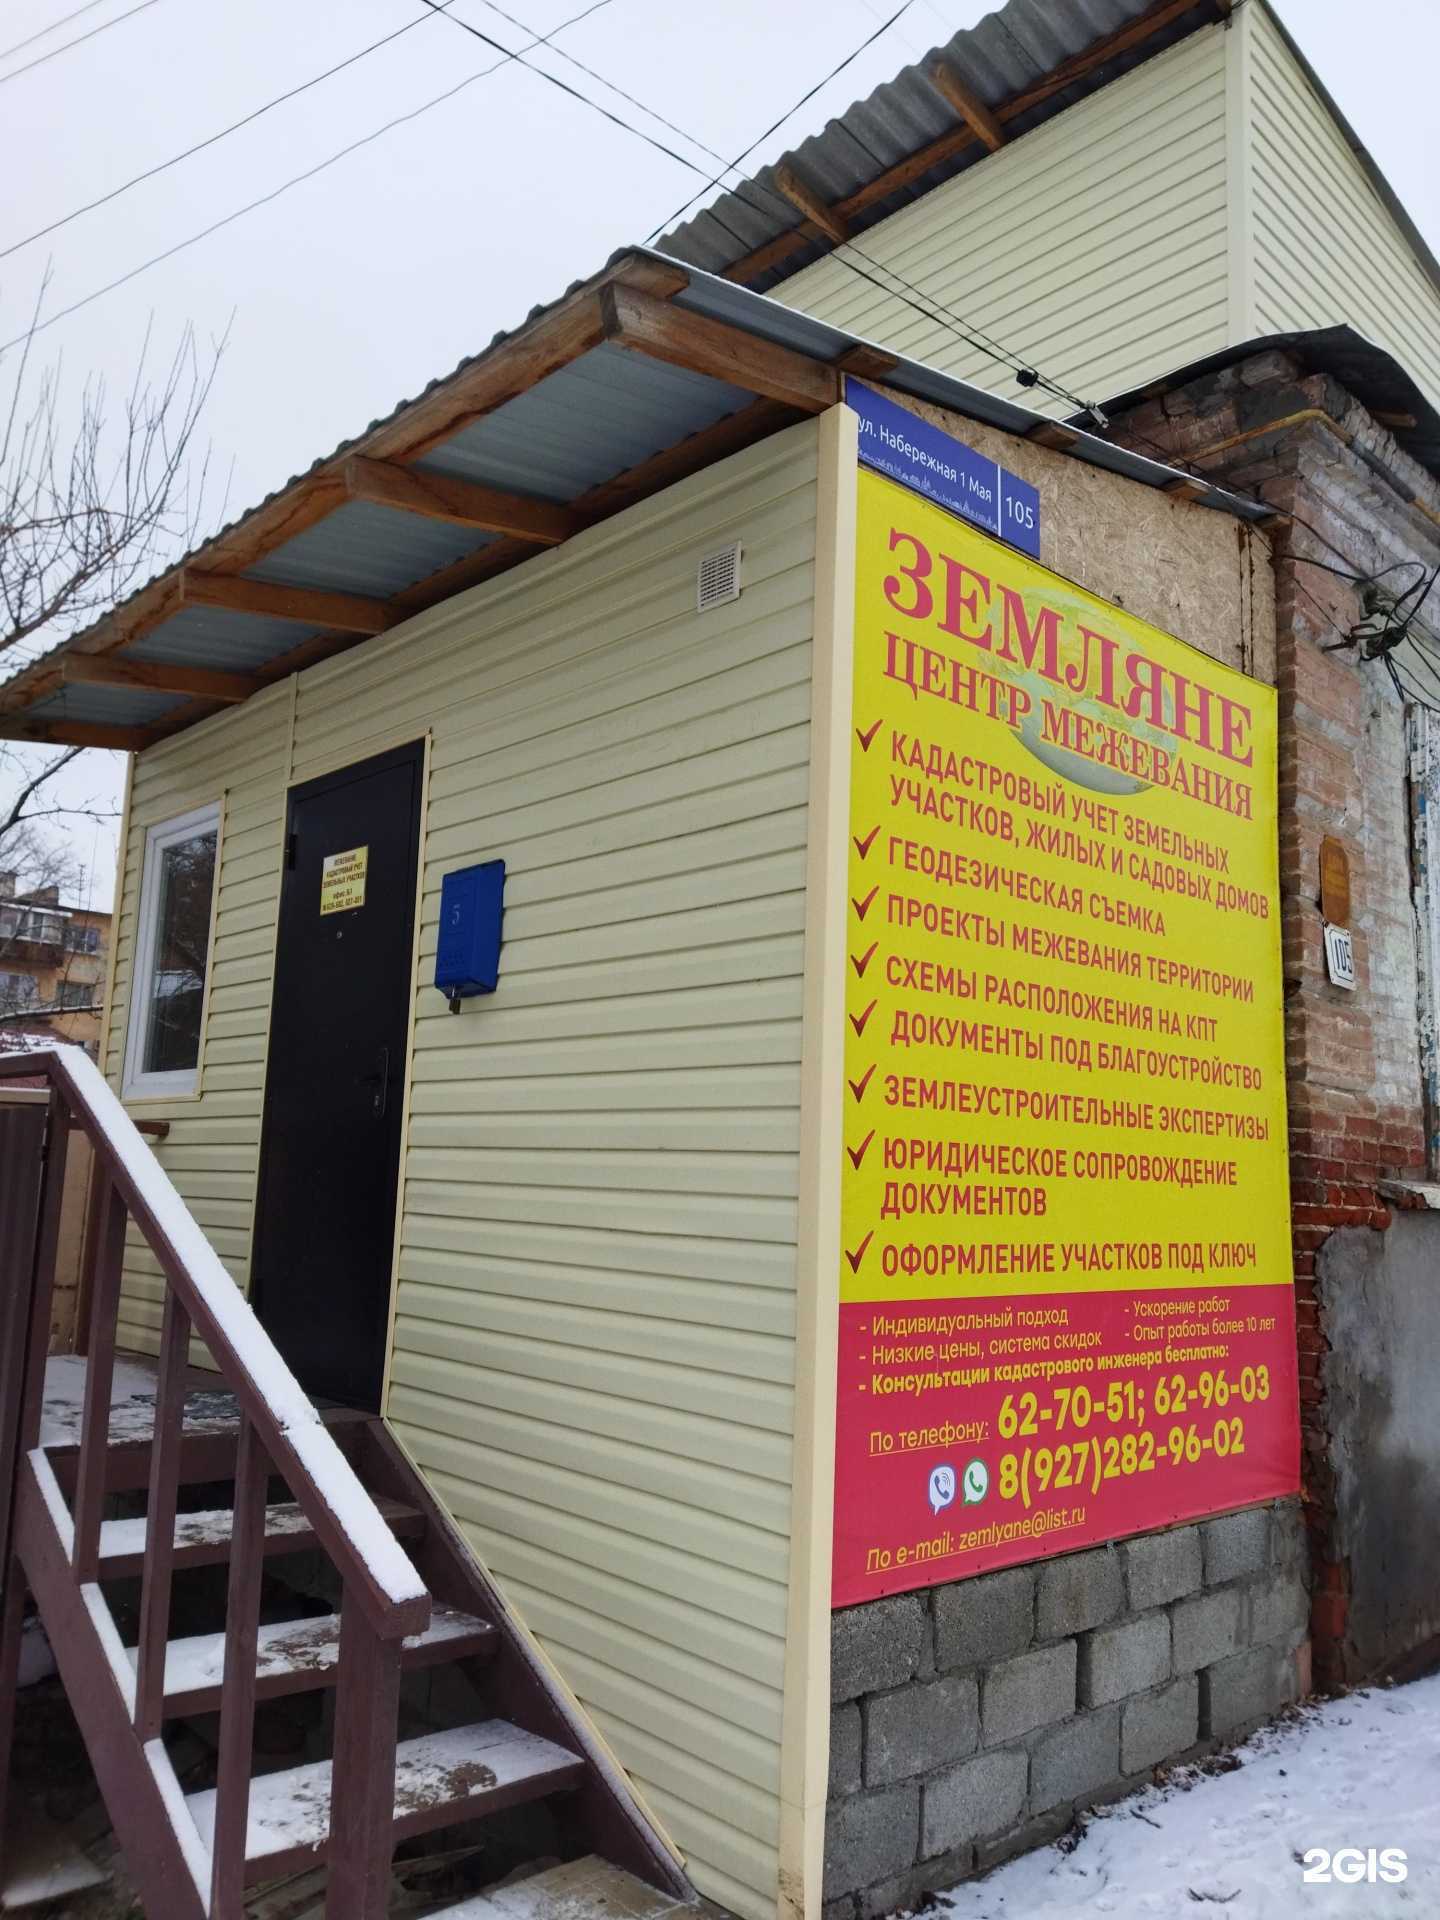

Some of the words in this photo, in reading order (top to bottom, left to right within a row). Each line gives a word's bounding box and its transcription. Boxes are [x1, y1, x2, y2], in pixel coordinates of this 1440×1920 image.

[858, 417, 877, 438] ул.
[880, 425, 957, 484] Набережная
[960, 471, 966, 486] 1
[969, 477, 992, 504] Мая
[1005, 496, 1034, 530] 105
[883, 527, 1253, 769] ЗЕМЛЯНЕ
[883, 631, 1032, 730] ЦЕНТР
[1041, 700, 1254, 821] МЕЖЕВАНИЯ
[892, 731, 1066, 815] КАДАСТРОВЫЙ
[1072, 799, 1119, 839] УЧЕТ
[1124, 814, 1230, 874] ЗЕМЕЛЬНЫХ
[890, 775, 1020, 849] УЧАСТКОВ,
[1026, 819, 1106, 869] ЖИЛЫХ
[1111, 849, 1124, 875] И
[1129, 853, 1212, 903] САДОВЫХ
[1216, 882, 1270, 920] ДОМОВ
[888, 836, 1083, 913] ГЕОДЕЗИЧЕСКАЯ
[1089, 893, 1166, 936] СЪЕМКА
[888, 894, 1005, 946] ПРОЕКТЫ
[1013, 928, 1141, 979] МЕЖЕВАНИЯ
[1147, 956, 1254, 1002] ТЕРРИТОРИИ
[1334, 939, 1353, 974] 105
[886, 955, 977, 1001] СХЕМЫ
[985, 974, 1153, 1031] РАСПОЛОЖЕНИЯ
[1159, 1008, 1181, 1036] НА
[1187, 1014, 1217, 1042] КПТ
[890, 1010, 1043, 1060] ДОКУМЕНТЫ
[1051, 1035, 1091, 1072] ПОД
[1098, 1042, 1262, 1091] БЛАГОУСТРОЙСТВО
[884, 1075, 1153, 1130] ЗЕМЛЕУСТРОИТЕЛЬНЫЕ
[1159, 1106, 1269, 1141] ЭКСПЕРТИЗЫ
[883, 1137, 1067, 1178] ЮРИДИЧЕСКОЕ
[1073, 1150, 1237, 1188] СОПРОВОЖДЕНИЕ
[880, 1181, 1047, 1220] ДОКУМЕНТОВ
[882, 1243, 1055, 1277] ОФОРМЛЕНИЕ
[1062, 1242, 1162, 1272] УЧАСТКОВ
[1168, 1243, 1204, 1274] ПОД
[1210, 1243, 1257, 1268] КЛЮЧ
[873, 1307, 1013, 1338] Индивидуальный
[1017, 1309, 1069, 1328] подход
[1133, 1300, 1196, 1320] Ускорение
[1198, 1296, 1230, 1315] работ
[1134, 1325, 1165, 1341] Опыт
[1168, 1320, 1210, 1343] работы
[1212, 1318, 1244, 1335] более
[1246, 1317, 1257, 1332] 10
[1259, 1317, 1276, 1332] лет
[872, 1345, 935, 1366] Низкие
[939, 1341, 985, 1362] цены,
[989, 1334, 1050, 1355] система
[1054, 1331, 1102, 1351] скидок
[872, 1367, 990, 1397] Консультации
[994, 1357, 1094, 1383] кадастрового
[1097, 1351, 1162, 1371] инженера
[1165, 1344, 1229, 1363] бесплатно:
[870, 1431, 893, 1453] По
[899, 1420, 989, 1450] телефону:
[998, 1379, 1145, 1440] 62-70-51;
[1154, 1365, 1271, 1416] 62-96-03
[999, 1417, 1246, 1508] 8(927)282-96-02
[866, 1548, 891, 1571] По
[897, 1531, 954, 1563] e-mail:
[959, 1507, 1086, 1550] zemlyane@list.ru
